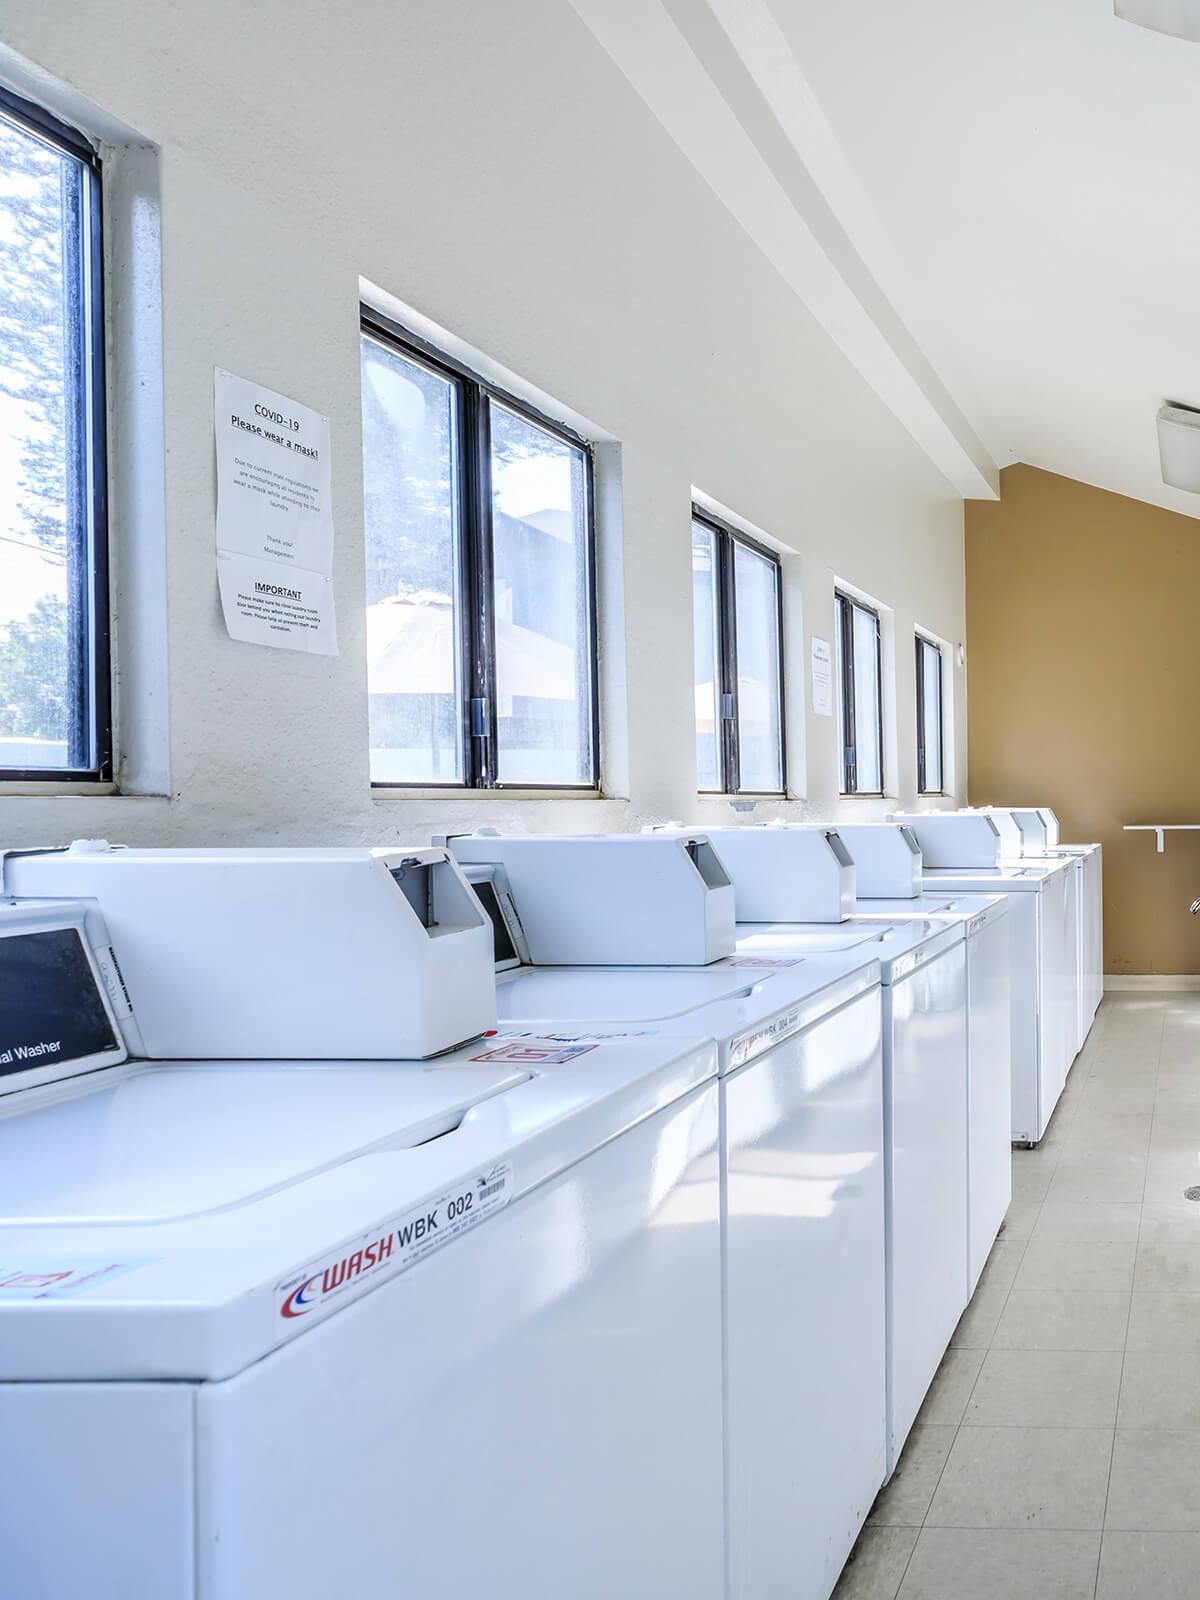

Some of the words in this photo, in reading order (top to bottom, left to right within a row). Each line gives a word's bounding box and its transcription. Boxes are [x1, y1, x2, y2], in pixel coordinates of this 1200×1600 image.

[254, 404, 300, 431] COVID-19
[231, 415, 262, 435] Please
[264, 429, 285, 445] wear
[286, 439, 292, 449] a
[294, 443, 319, 460] mask!
[254, 582, 302, 601] IMPORTANT
[14, 1041, 61, 1060] Washer
[321, 1233, 394, 1293] WASH
[397, 1209, 439, 1249] WBK
[447, 1191, 474, 1220] 002
